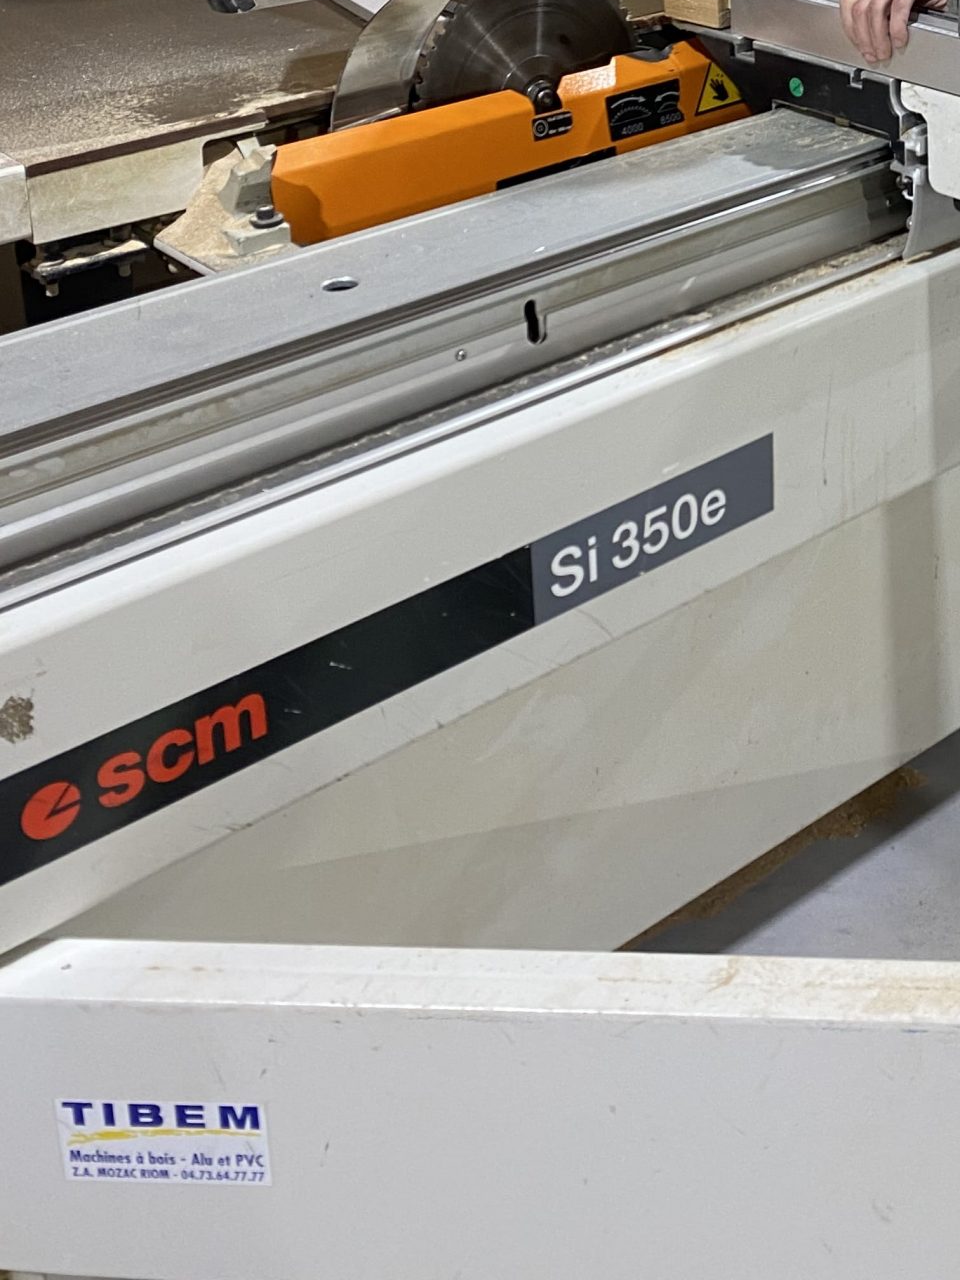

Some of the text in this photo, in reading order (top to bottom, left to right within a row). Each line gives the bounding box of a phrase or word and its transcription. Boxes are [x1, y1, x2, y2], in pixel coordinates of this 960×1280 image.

[621, 122, 644, 136] 4000
[550, 488, 727, 597] Si 350e
[97, 692, 268, 808] scm
[61, 1102, 260, 1130] TIBEM
[69, 1149, 131, 1164] Machines
[136, 1152, 144, 1164] à
[147, 1151, 176, 1165] bois
[191, 1153, 213, 1166] Alu
[217, 1156, 231, 1166] et
[235, 1154, 264, 1167] PVC
[97, 1167, 137, 1178] MOZAC
[141, 1168, 169, 1179] RIOM
